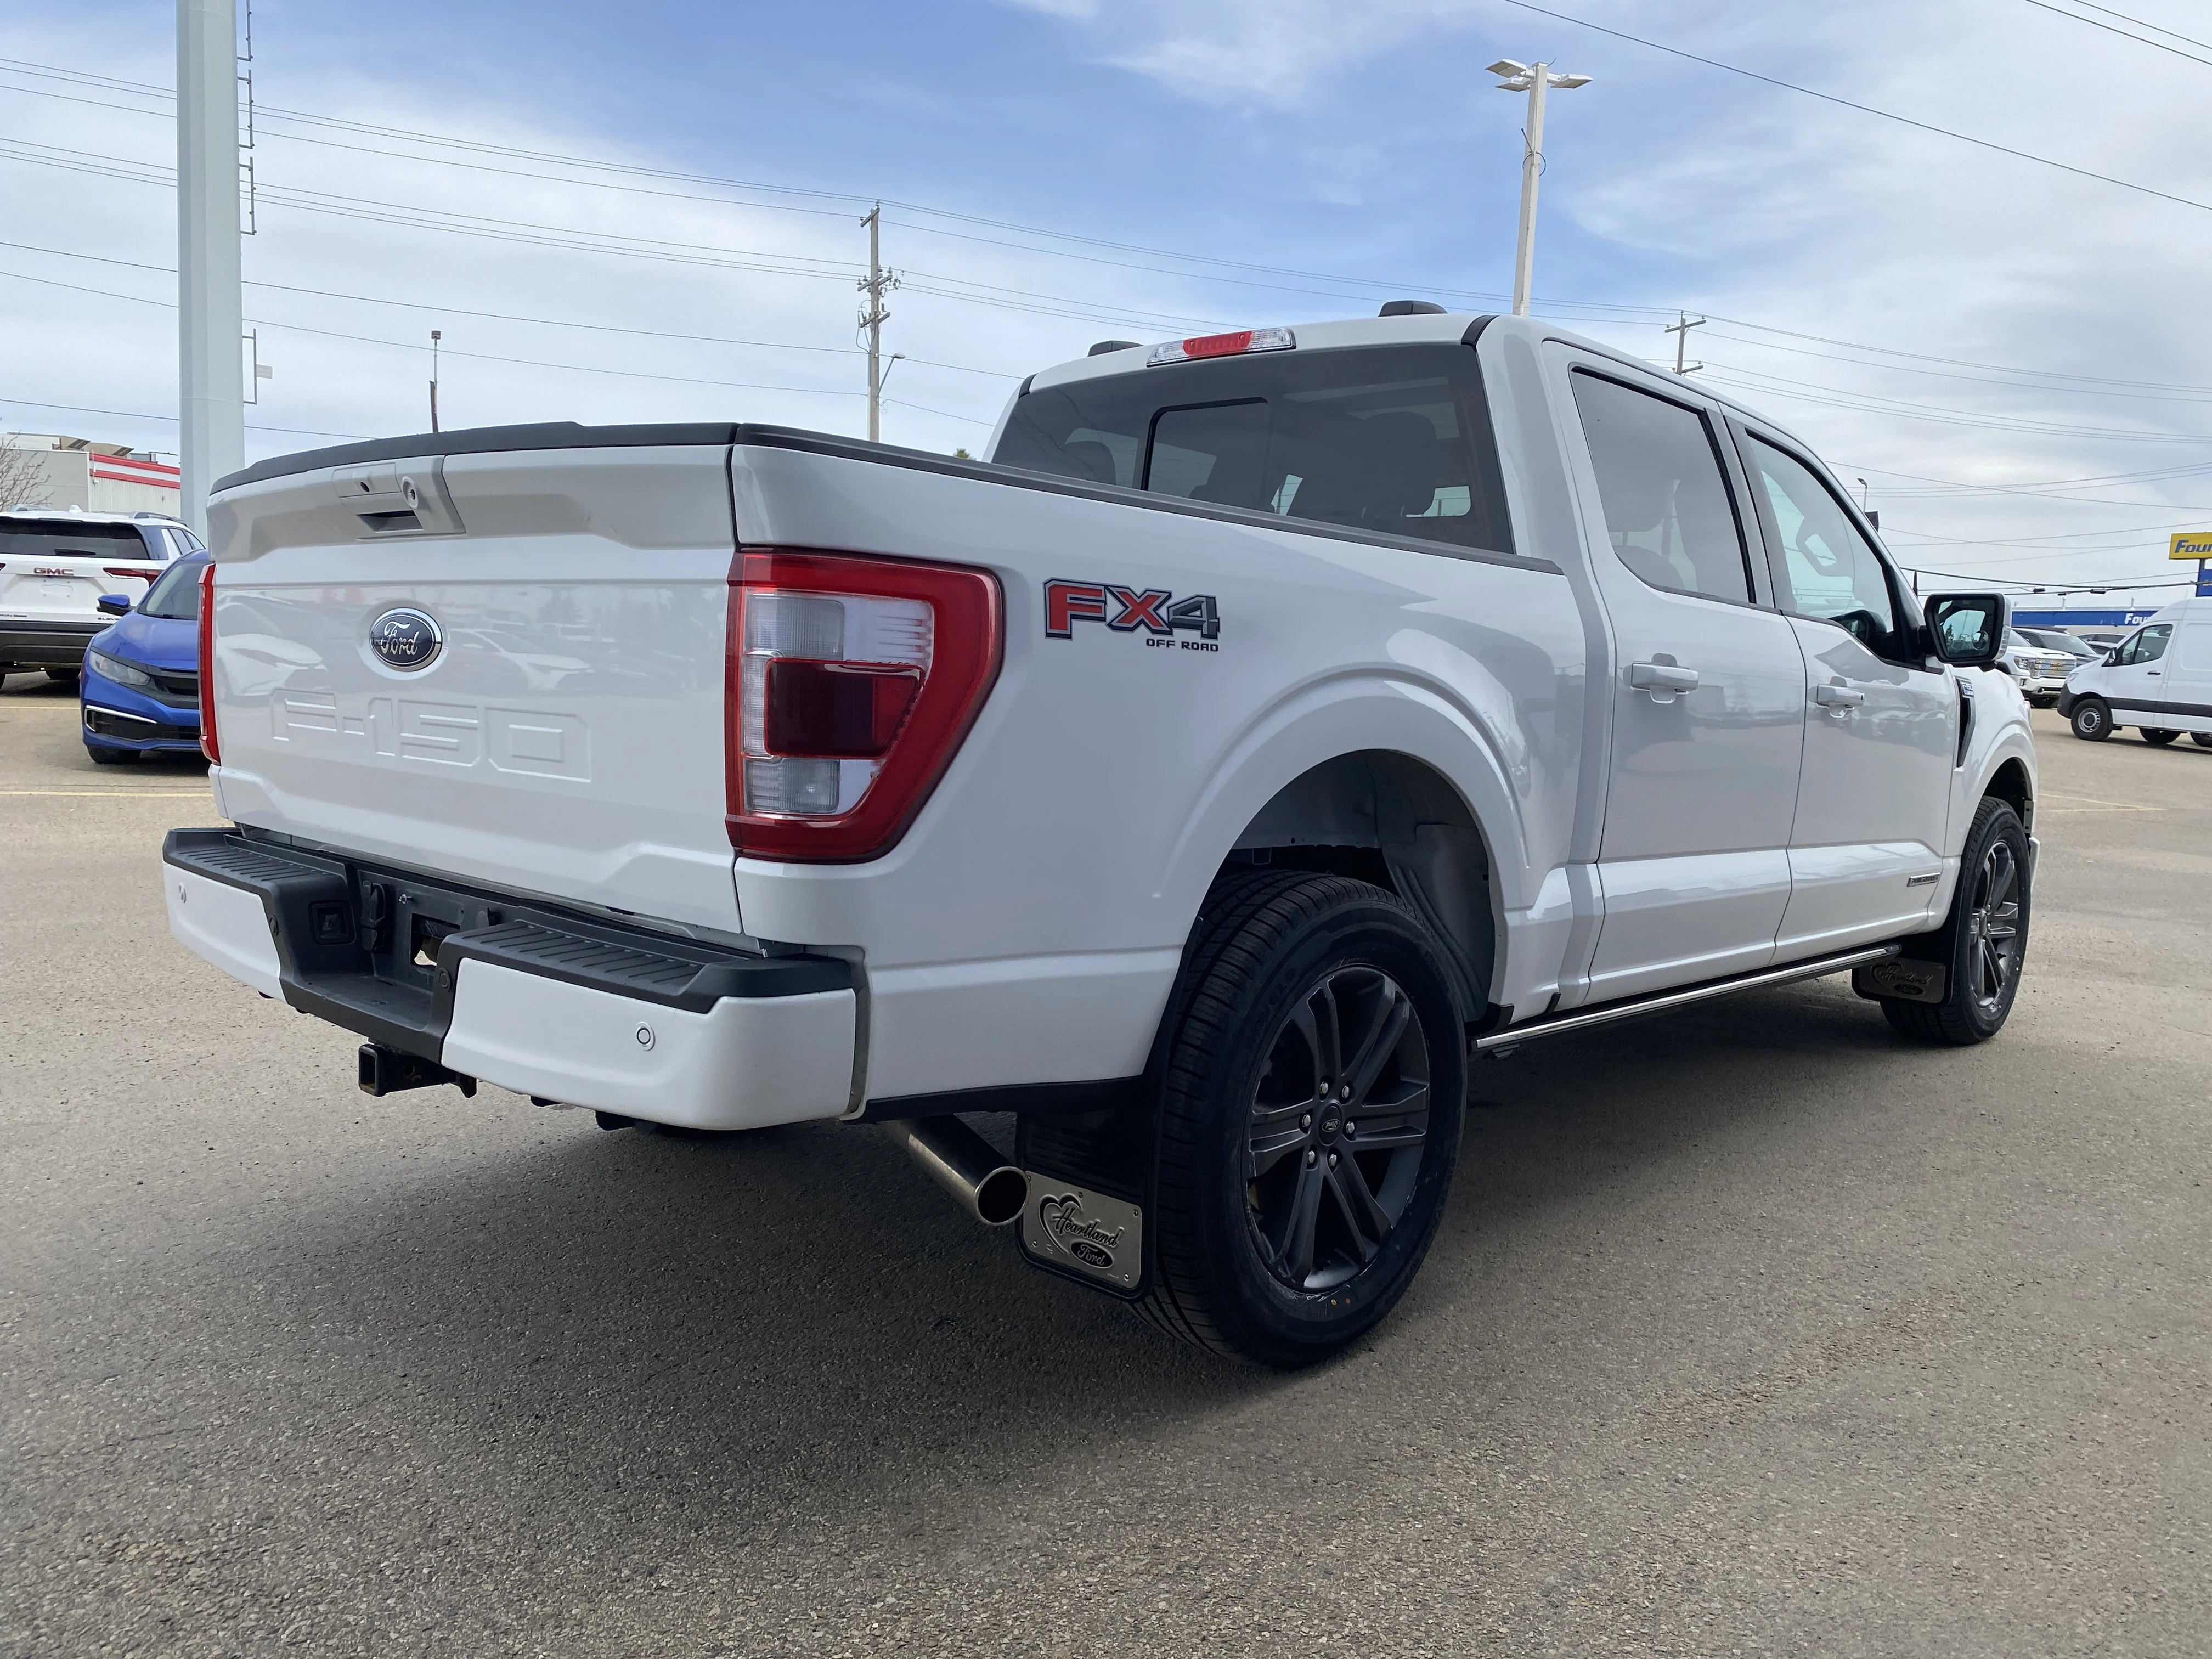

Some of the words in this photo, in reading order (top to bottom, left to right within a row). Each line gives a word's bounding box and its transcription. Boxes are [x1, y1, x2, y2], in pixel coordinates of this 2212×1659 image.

[1043, 577, 1220, 640] FX4
[380, 620, 420, 656] Ford
[1146, 638, 1176, 648] OFF
[1181, 641, 1218, 652] ROAD
[269, 686, 592, 783] F-150
[1052, 1208, 1123, 1247] Heartland
[1077, 1243, 1105, 1266] Ford
